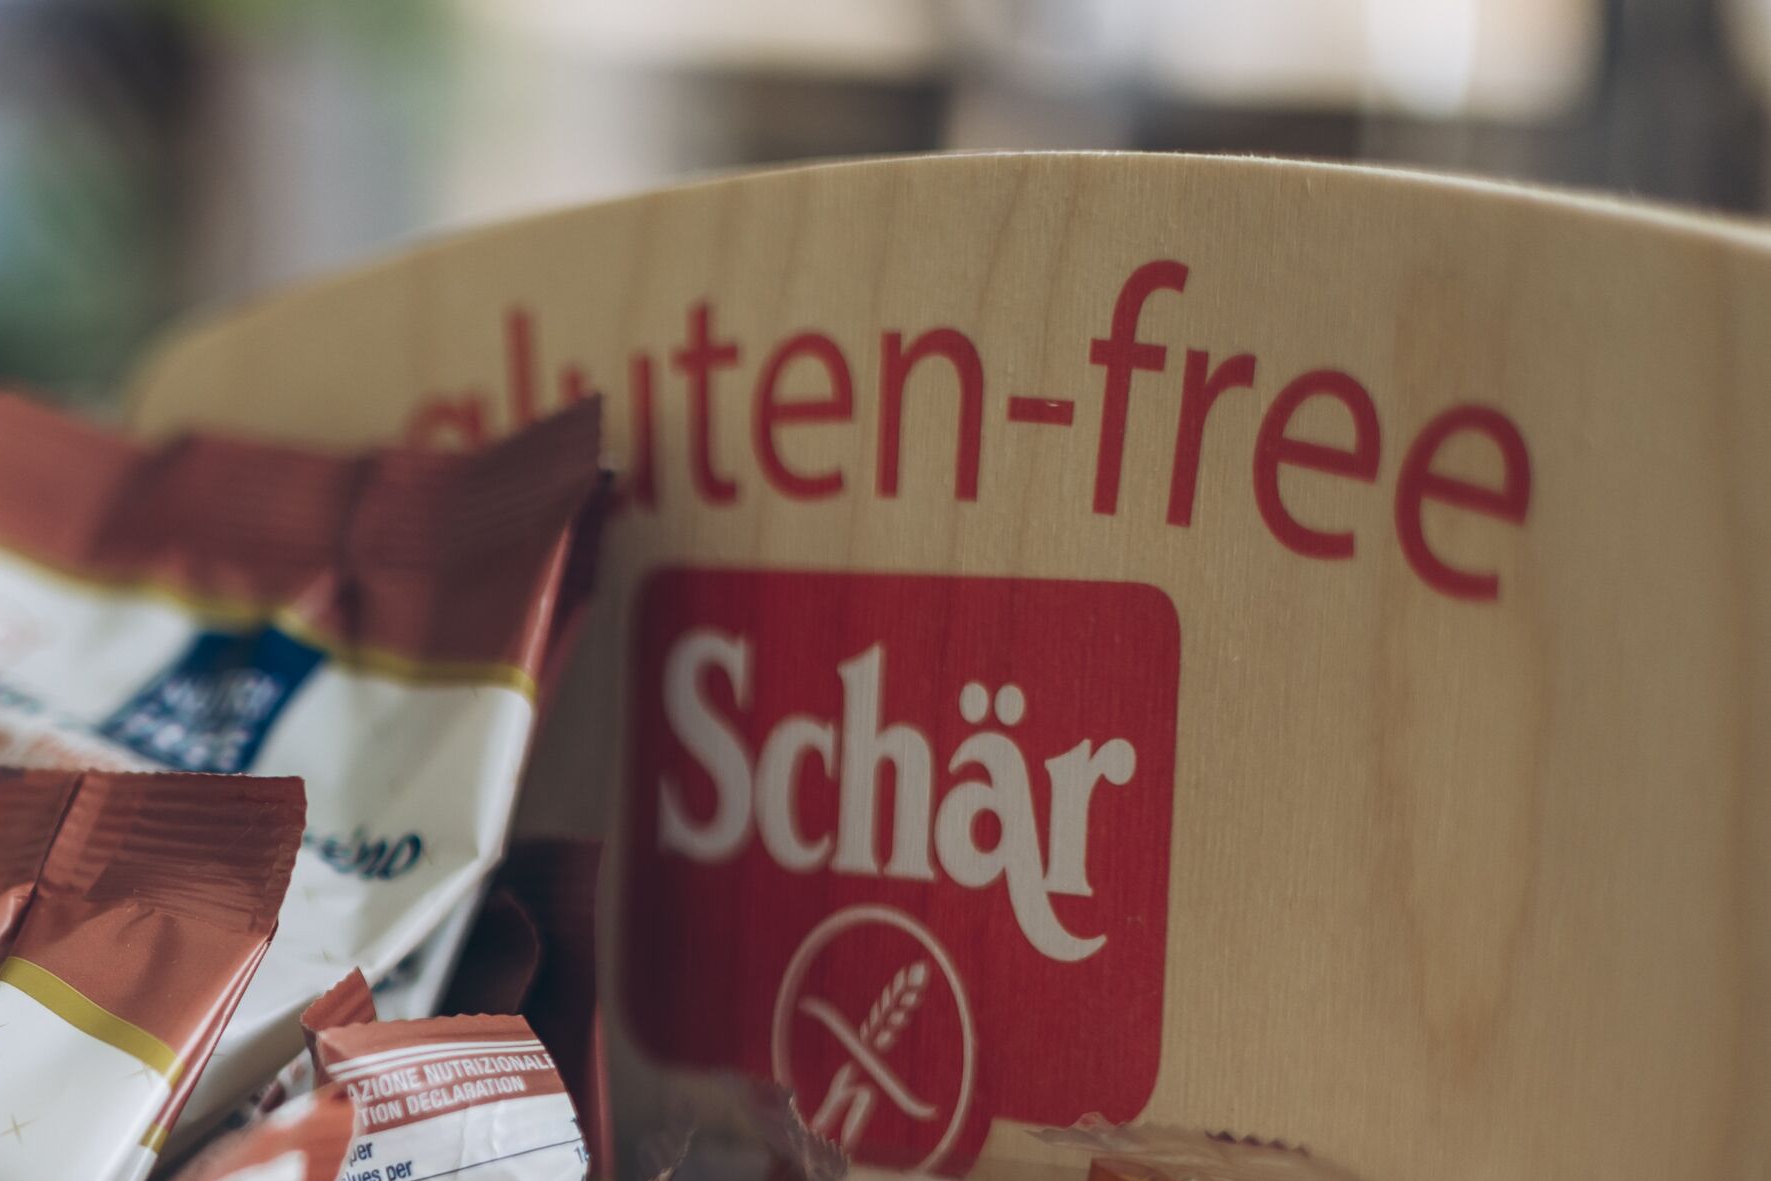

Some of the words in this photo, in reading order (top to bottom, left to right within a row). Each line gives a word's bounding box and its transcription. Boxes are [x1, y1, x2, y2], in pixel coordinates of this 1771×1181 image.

[657, 628, 1138, 963] Schär
[346, 1068, 423, 1104] AZIONE
[358, 1100, 404, 1127] TION
[405, 1076, 526, 1115] DECLARATION
